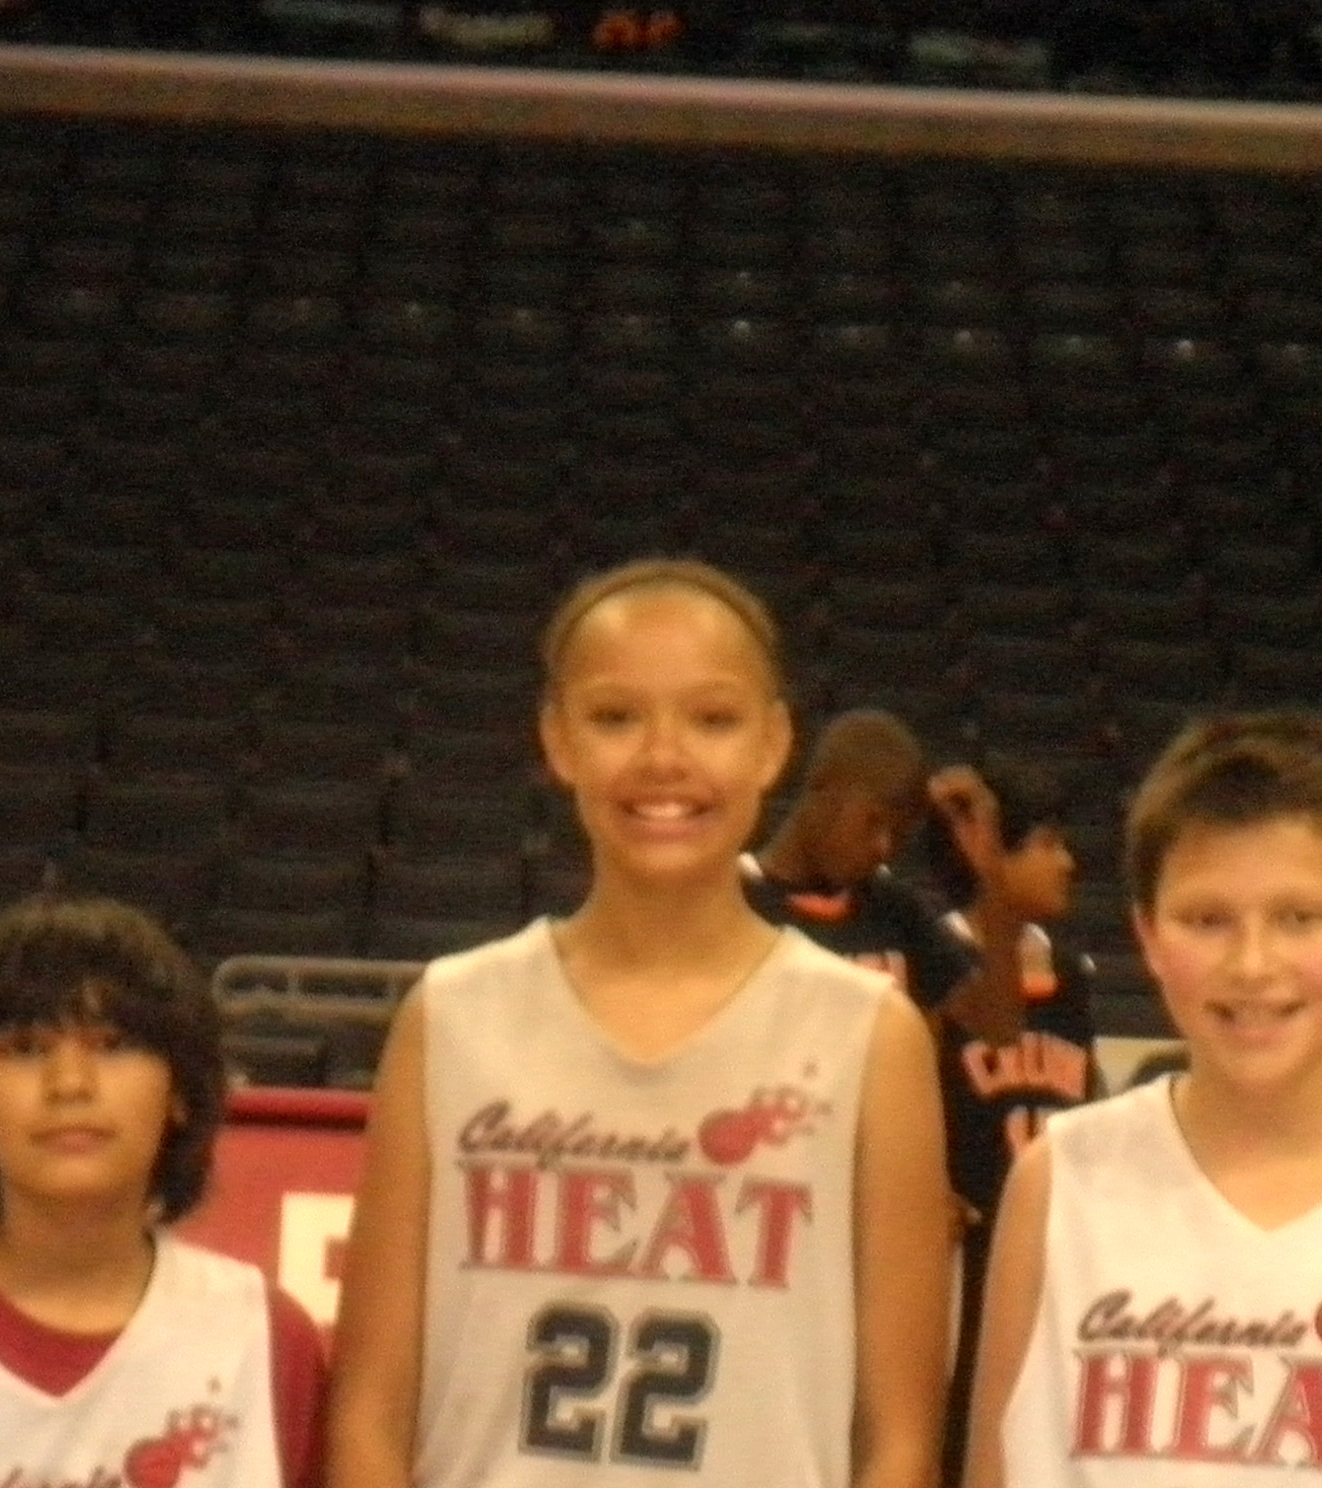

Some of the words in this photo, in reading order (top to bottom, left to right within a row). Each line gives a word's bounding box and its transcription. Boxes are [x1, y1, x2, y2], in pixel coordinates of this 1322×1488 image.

[457, 1097, 691, 1170] California
[453, 1152, 815, 1290] HEAT
[1077, 1288, 1310, 1358] California
[518, 1299, 723, 1473] 22
